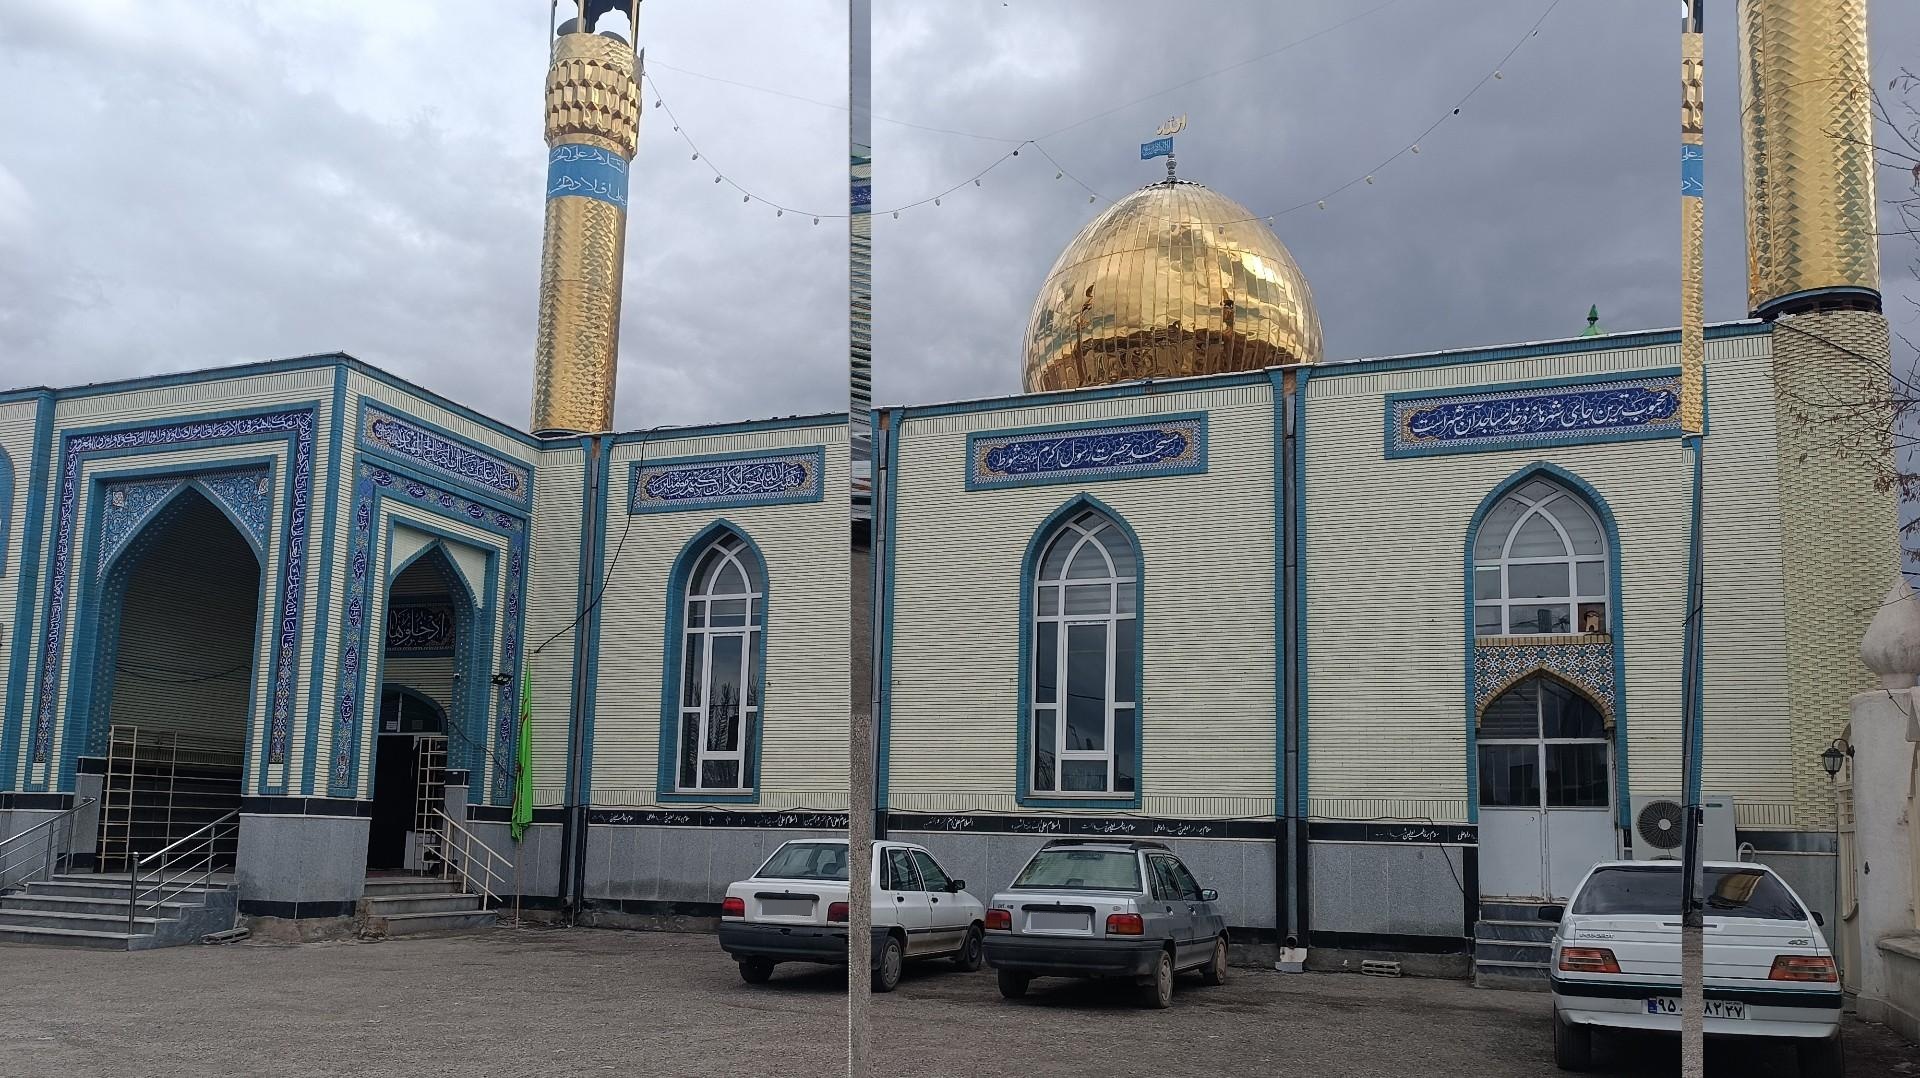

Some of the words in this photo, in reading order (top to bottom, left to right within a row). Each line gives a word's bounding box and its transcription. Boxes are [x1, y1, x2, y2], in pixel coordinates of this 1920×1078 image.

[1413, 415, 1446, 433] است
[1561, 400, 1594, 427] جای
[1060, 440, 1091, 467] رسول
[1091, 437, 1131, 464] حضرت
[1126, 434, 1178, 459] مسجد
[1787, 939, 1809, 947] 405
